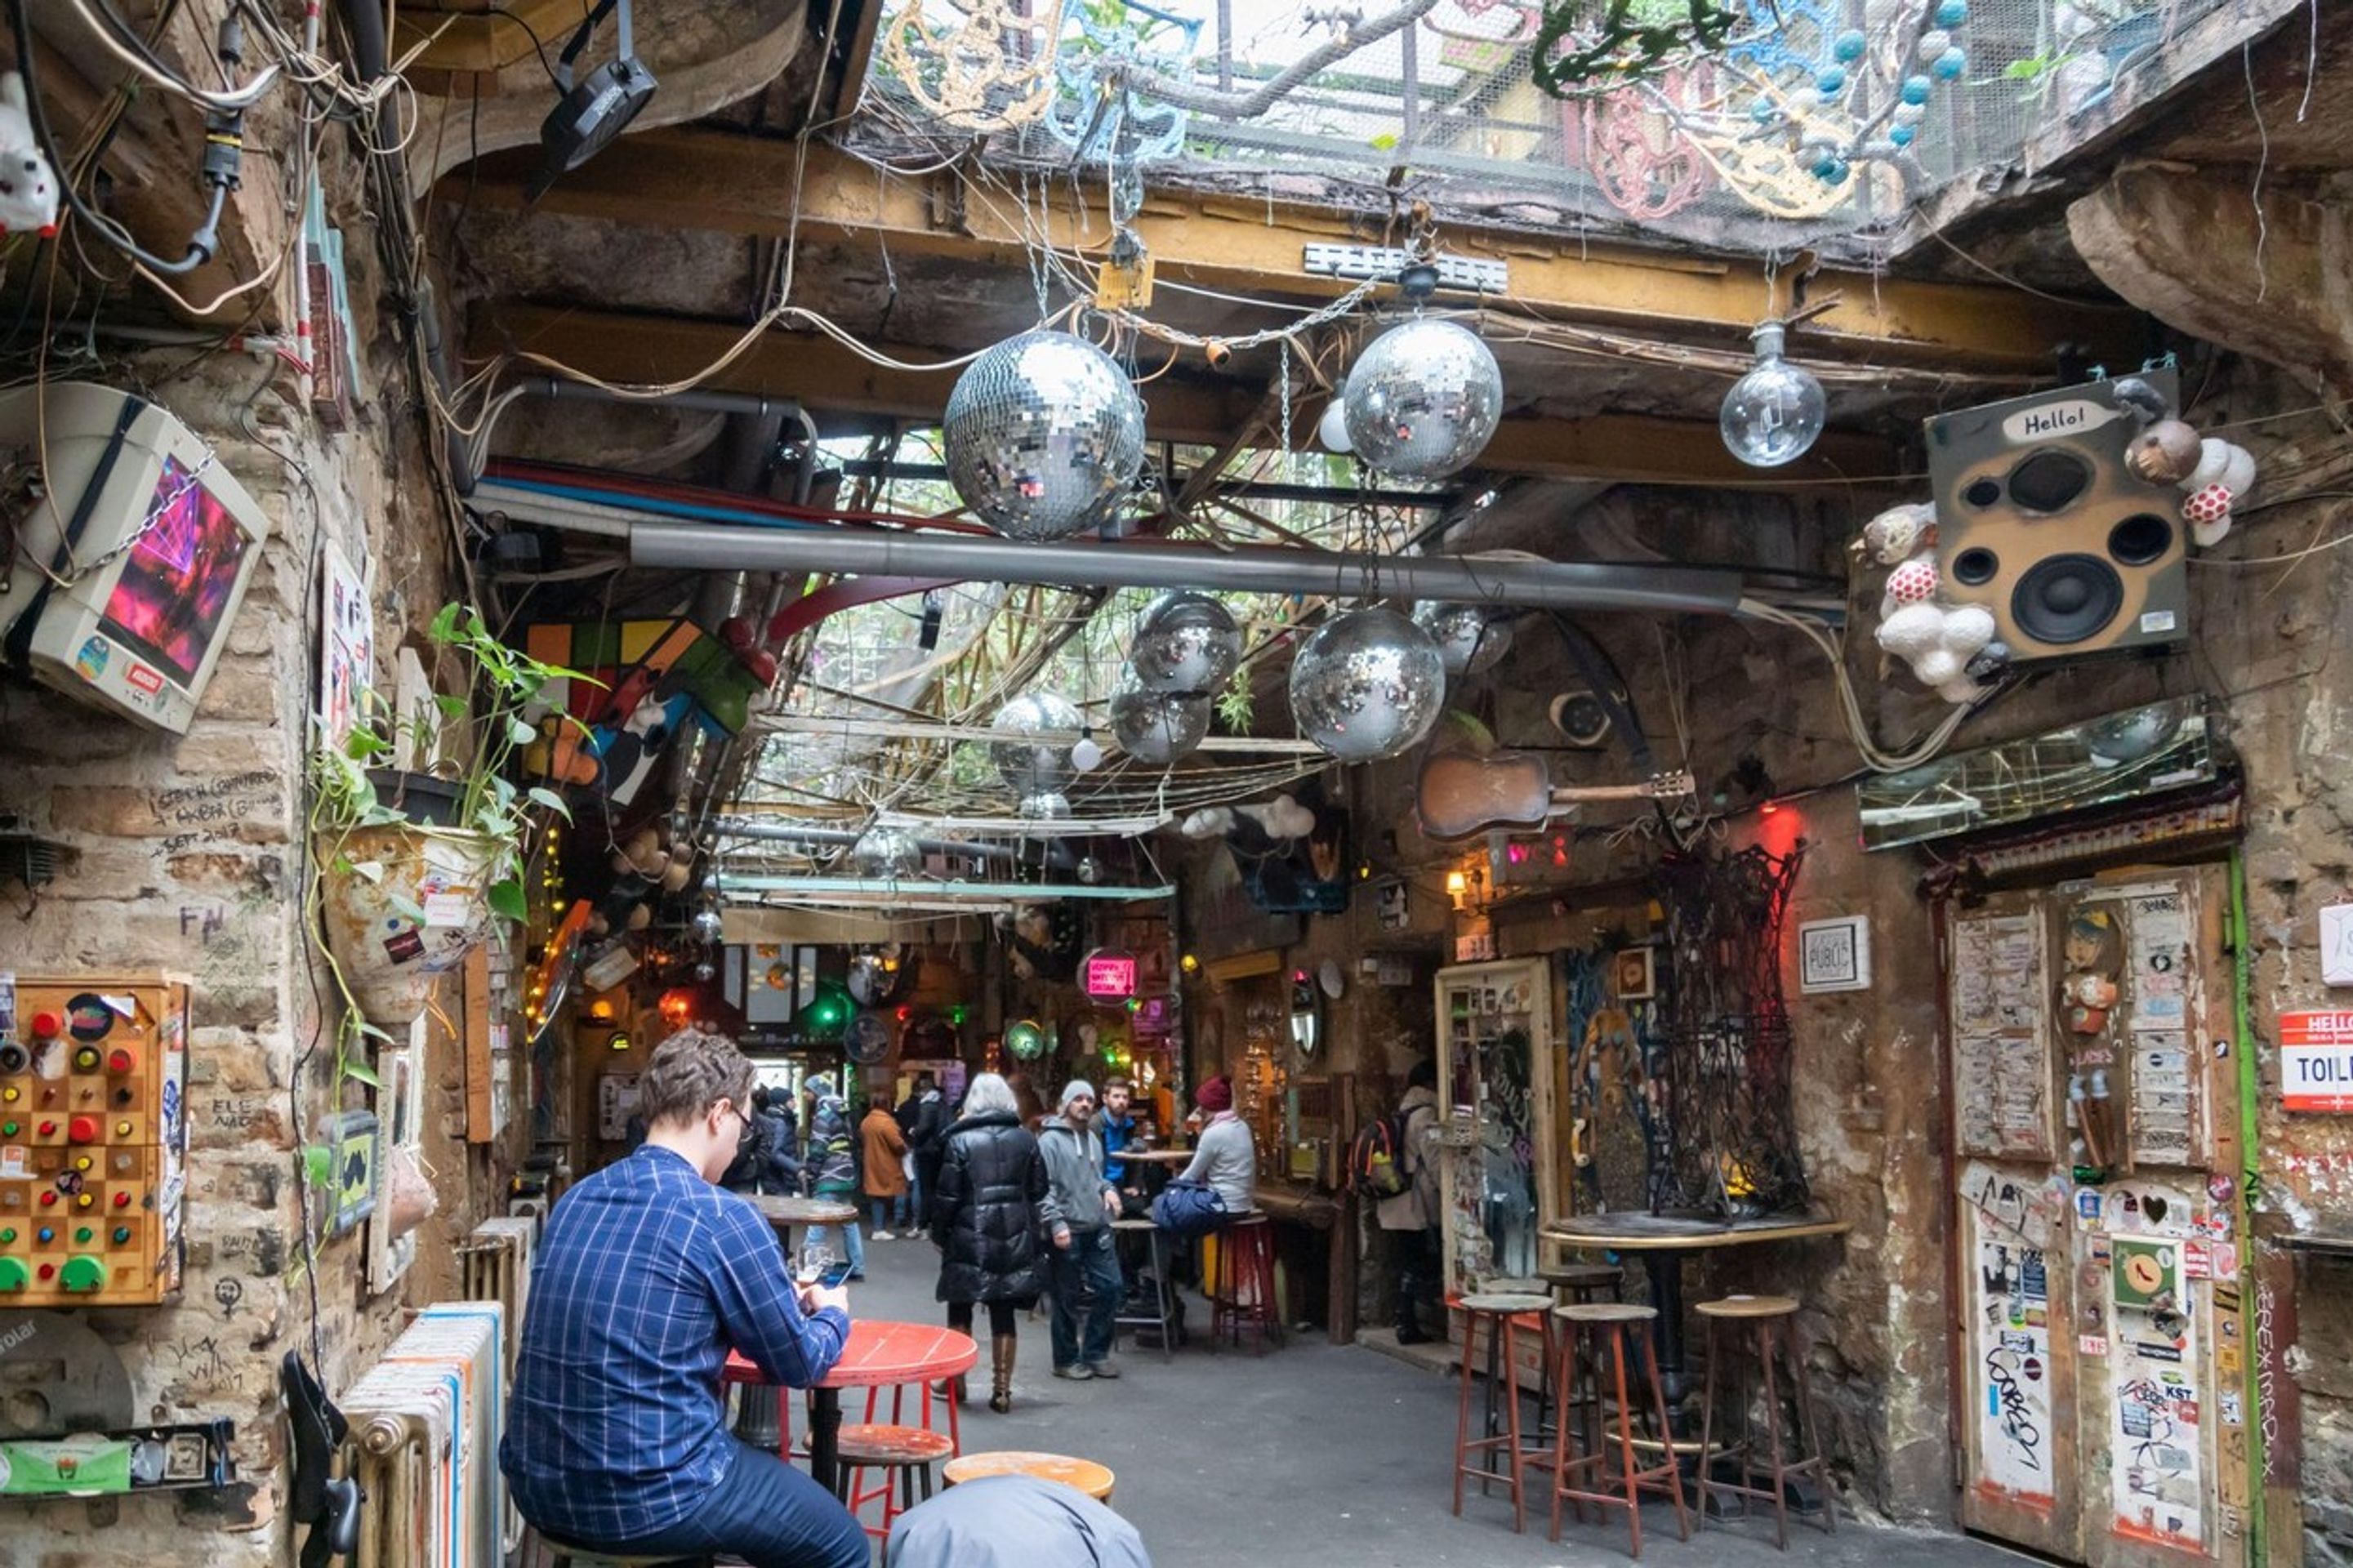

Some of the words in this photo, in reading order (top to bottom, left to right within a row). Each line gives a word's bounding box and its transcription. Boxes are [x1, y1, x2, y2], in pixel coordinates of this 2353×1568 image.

[2025, 407, 2084, 434] Hello!
[2297, 1055, 2353, 1082] TOIL
[0, 1319, 37, 1355] olar
[2166, 1386, 2193, 1401] KST
